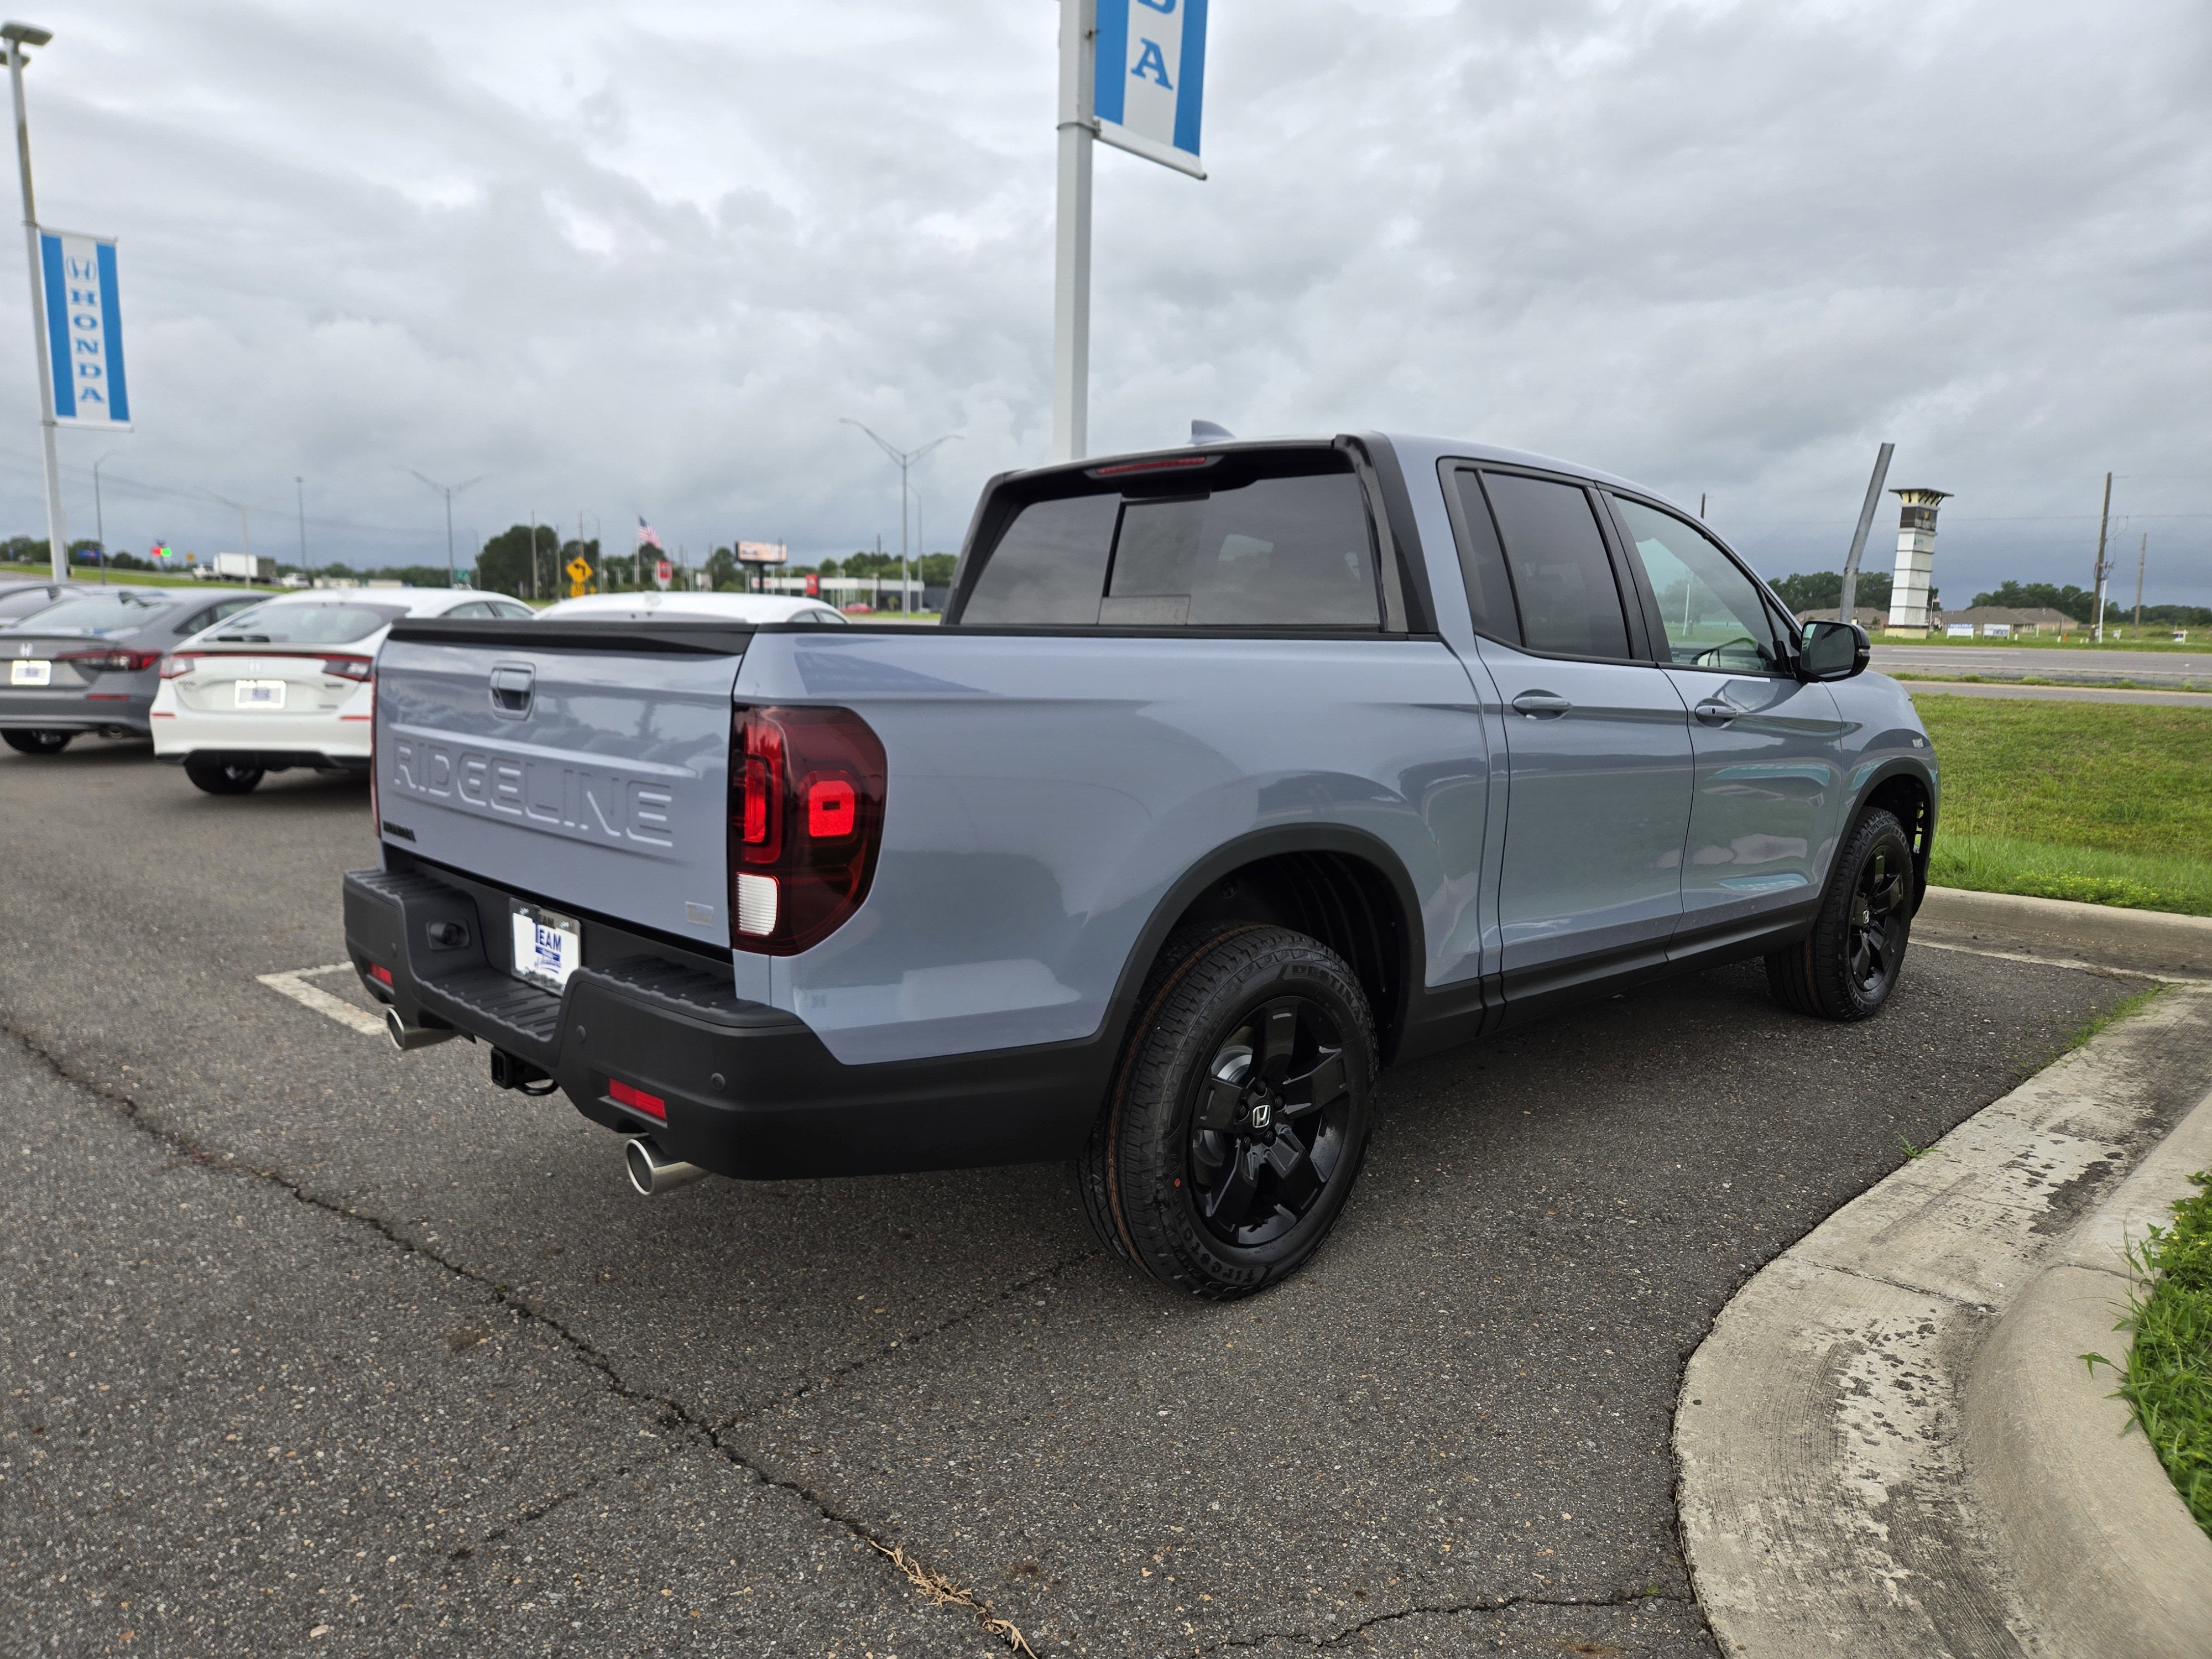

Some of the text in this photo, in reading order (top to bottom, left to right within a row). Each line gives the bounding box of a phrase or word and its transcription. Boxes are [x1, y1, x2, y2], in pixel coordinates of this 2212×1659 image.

[70, 289, 104, 402] HONDA
[393, 738, 674, 847] RIDGELINE
[534, 922, 562, 952] TEAM
